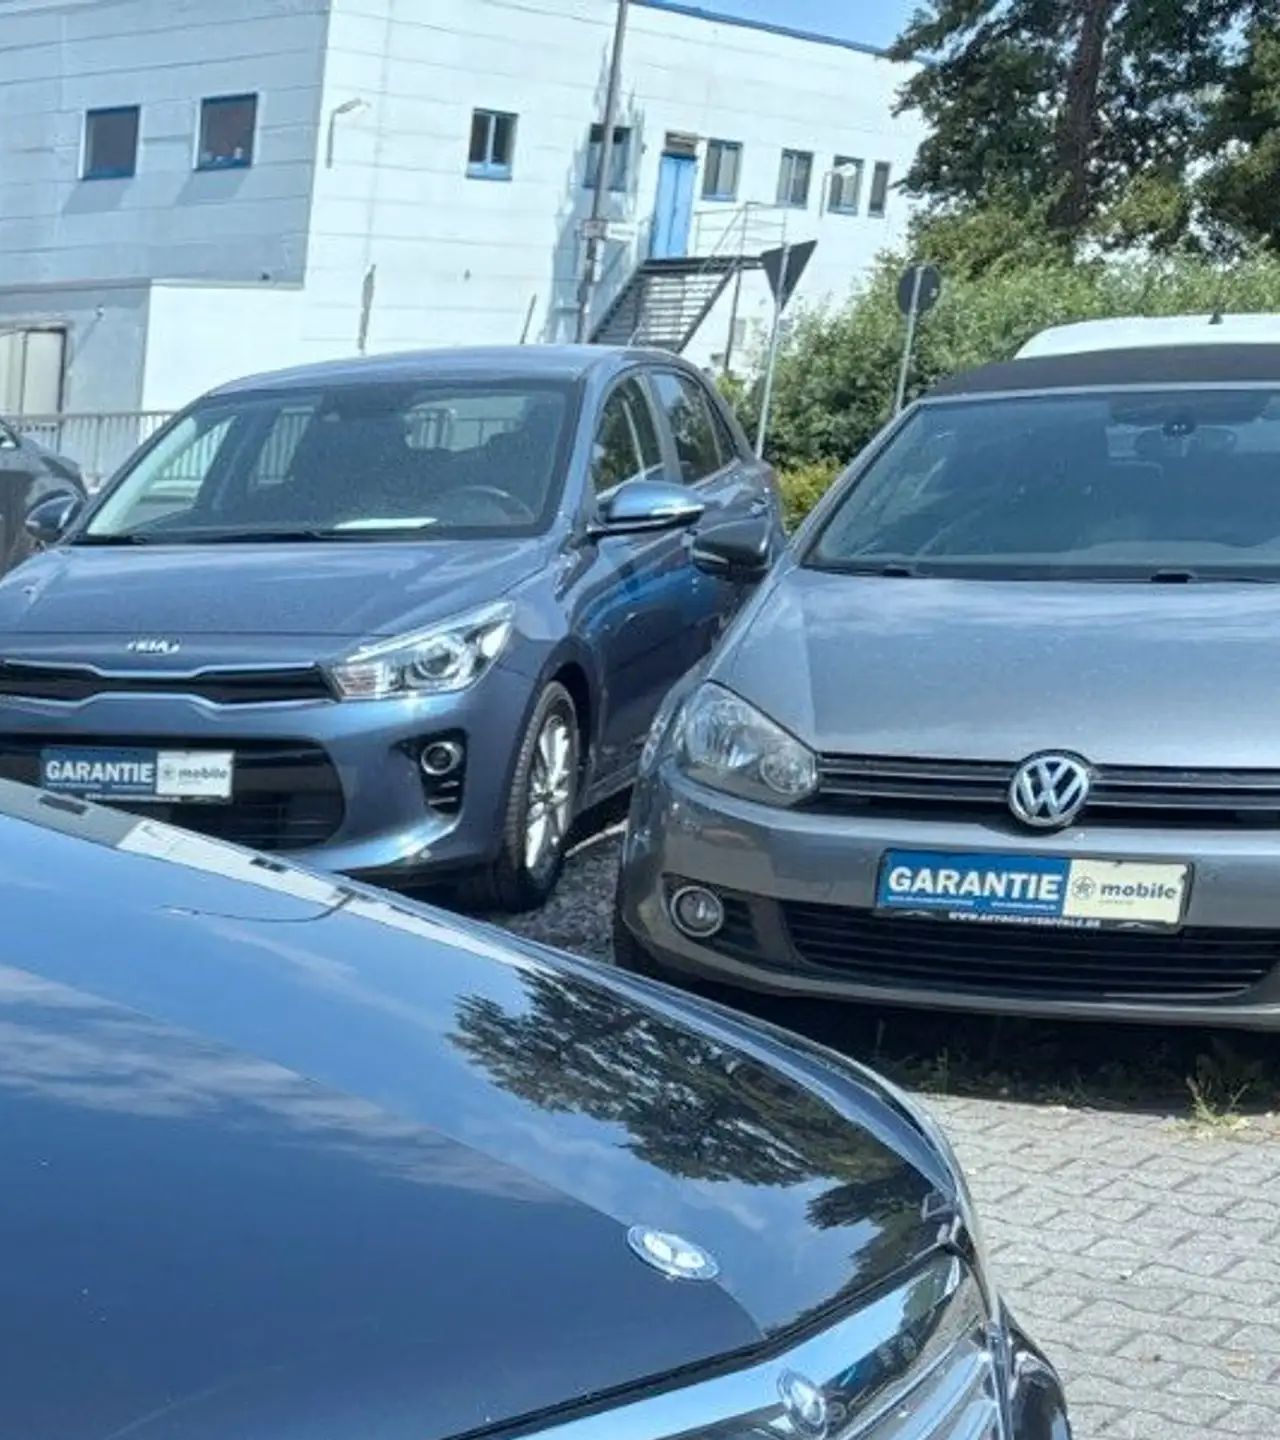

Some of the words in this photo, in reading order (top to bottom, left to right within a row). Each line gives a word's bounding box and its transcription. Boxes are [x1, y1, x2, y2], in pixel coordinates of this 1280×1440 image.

[45, 760, 154, 783] GARANTIE
[888, 865, 1063, 901] GARANTIE
[1100, 882, 1177, 899] mobile
